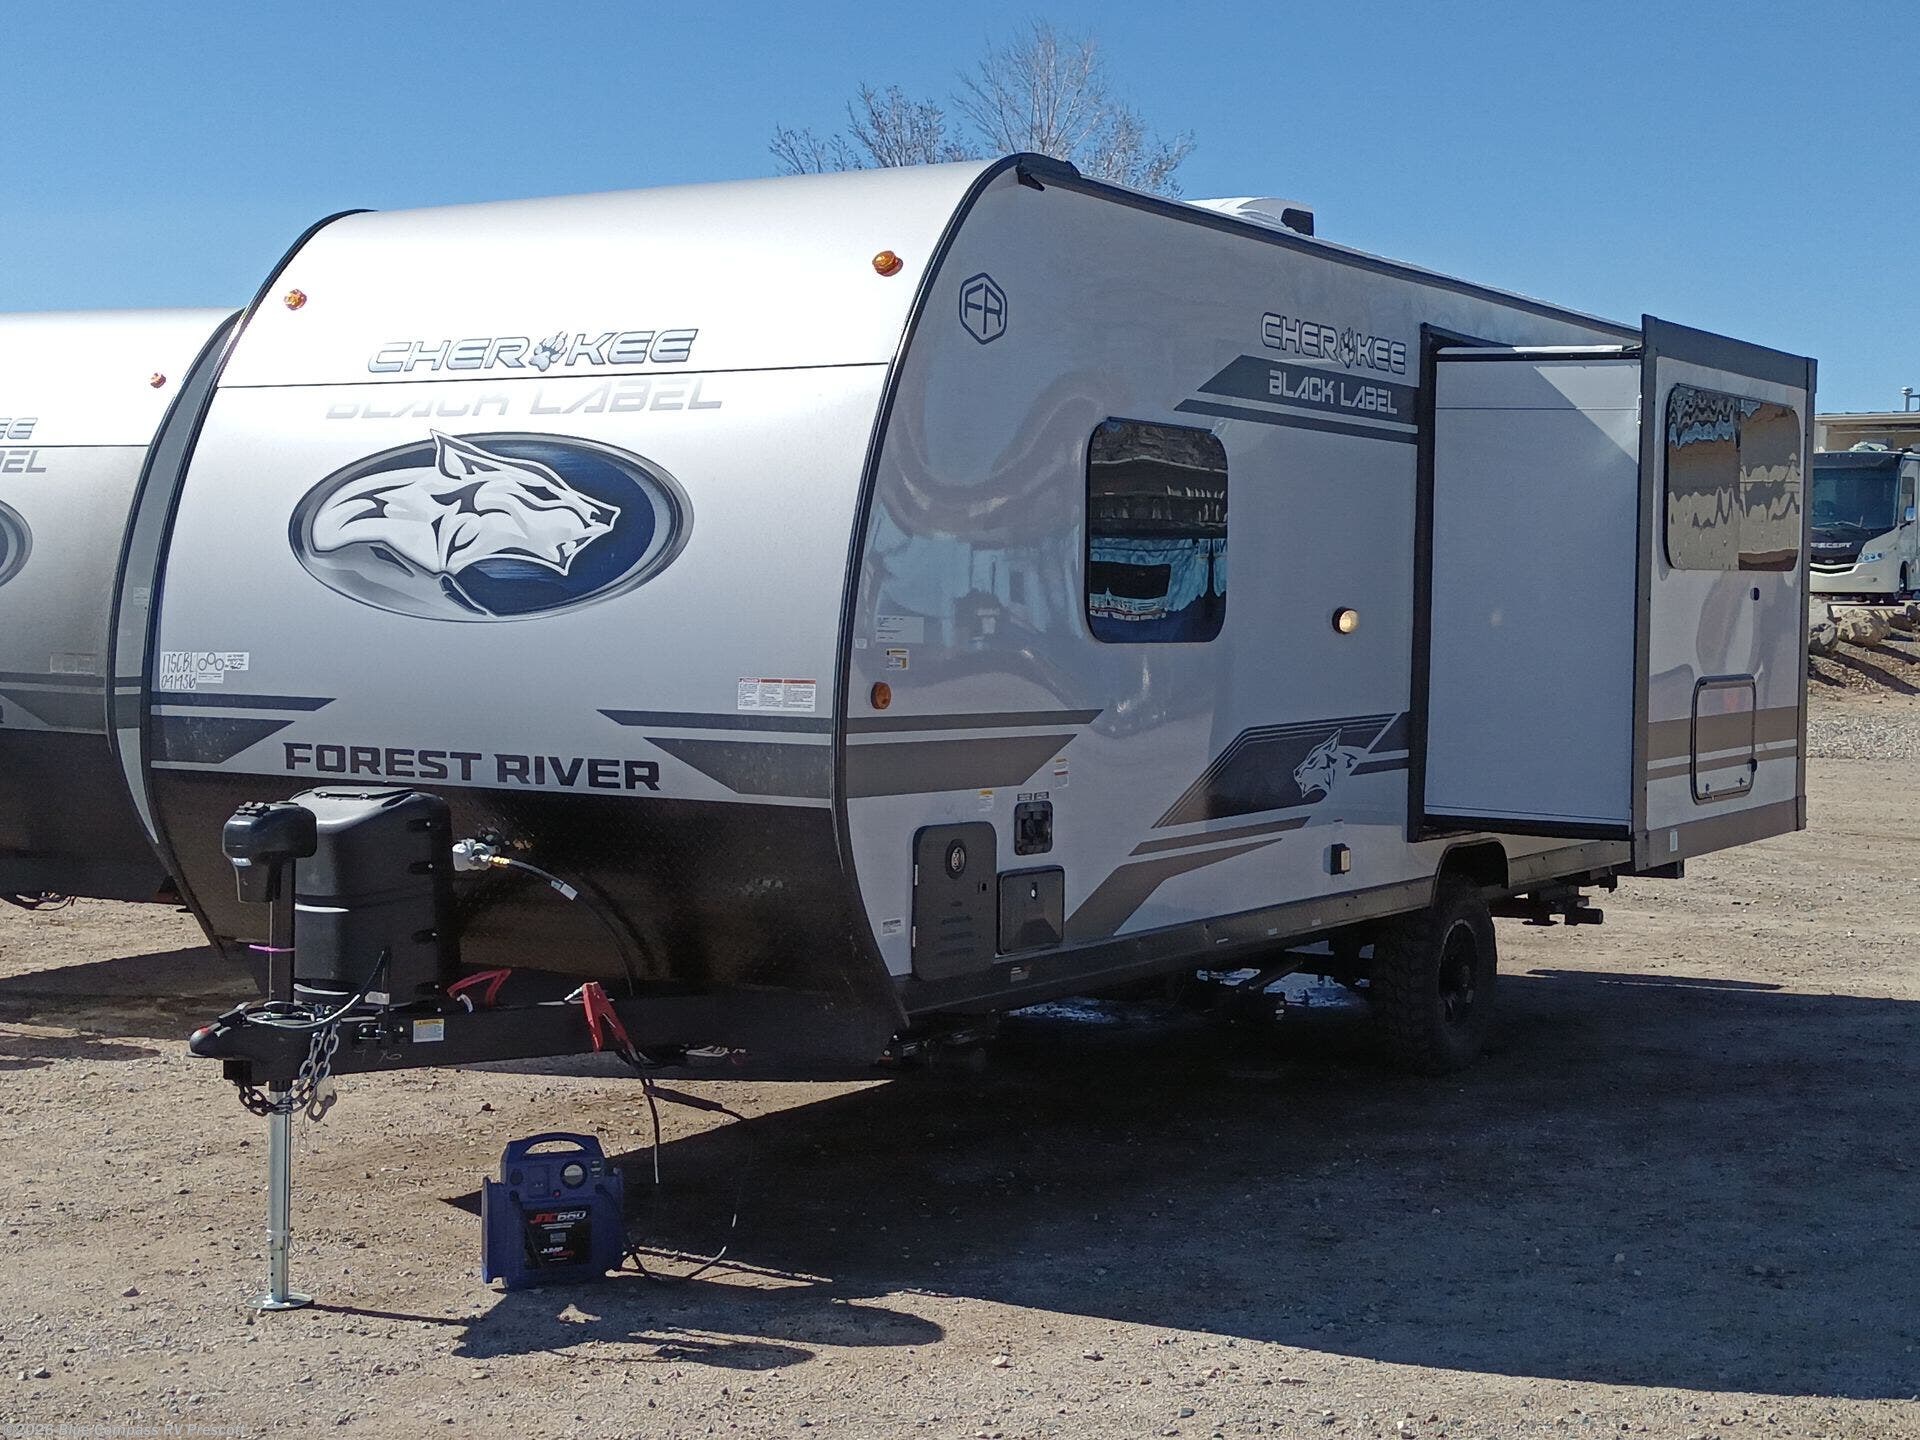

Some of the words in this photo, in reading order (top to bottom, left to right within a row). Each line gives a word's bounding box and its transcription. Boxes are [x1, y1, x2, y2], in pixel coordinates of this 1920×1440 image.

[529, 377, 723, 415] LABEL
[1268, 369, 1335, 405] BLACK
[1340, 382, 1398, 415] LABEL
[282, 741, 482, 781] FOREST
[493, 752, 663, 791] RIVER
